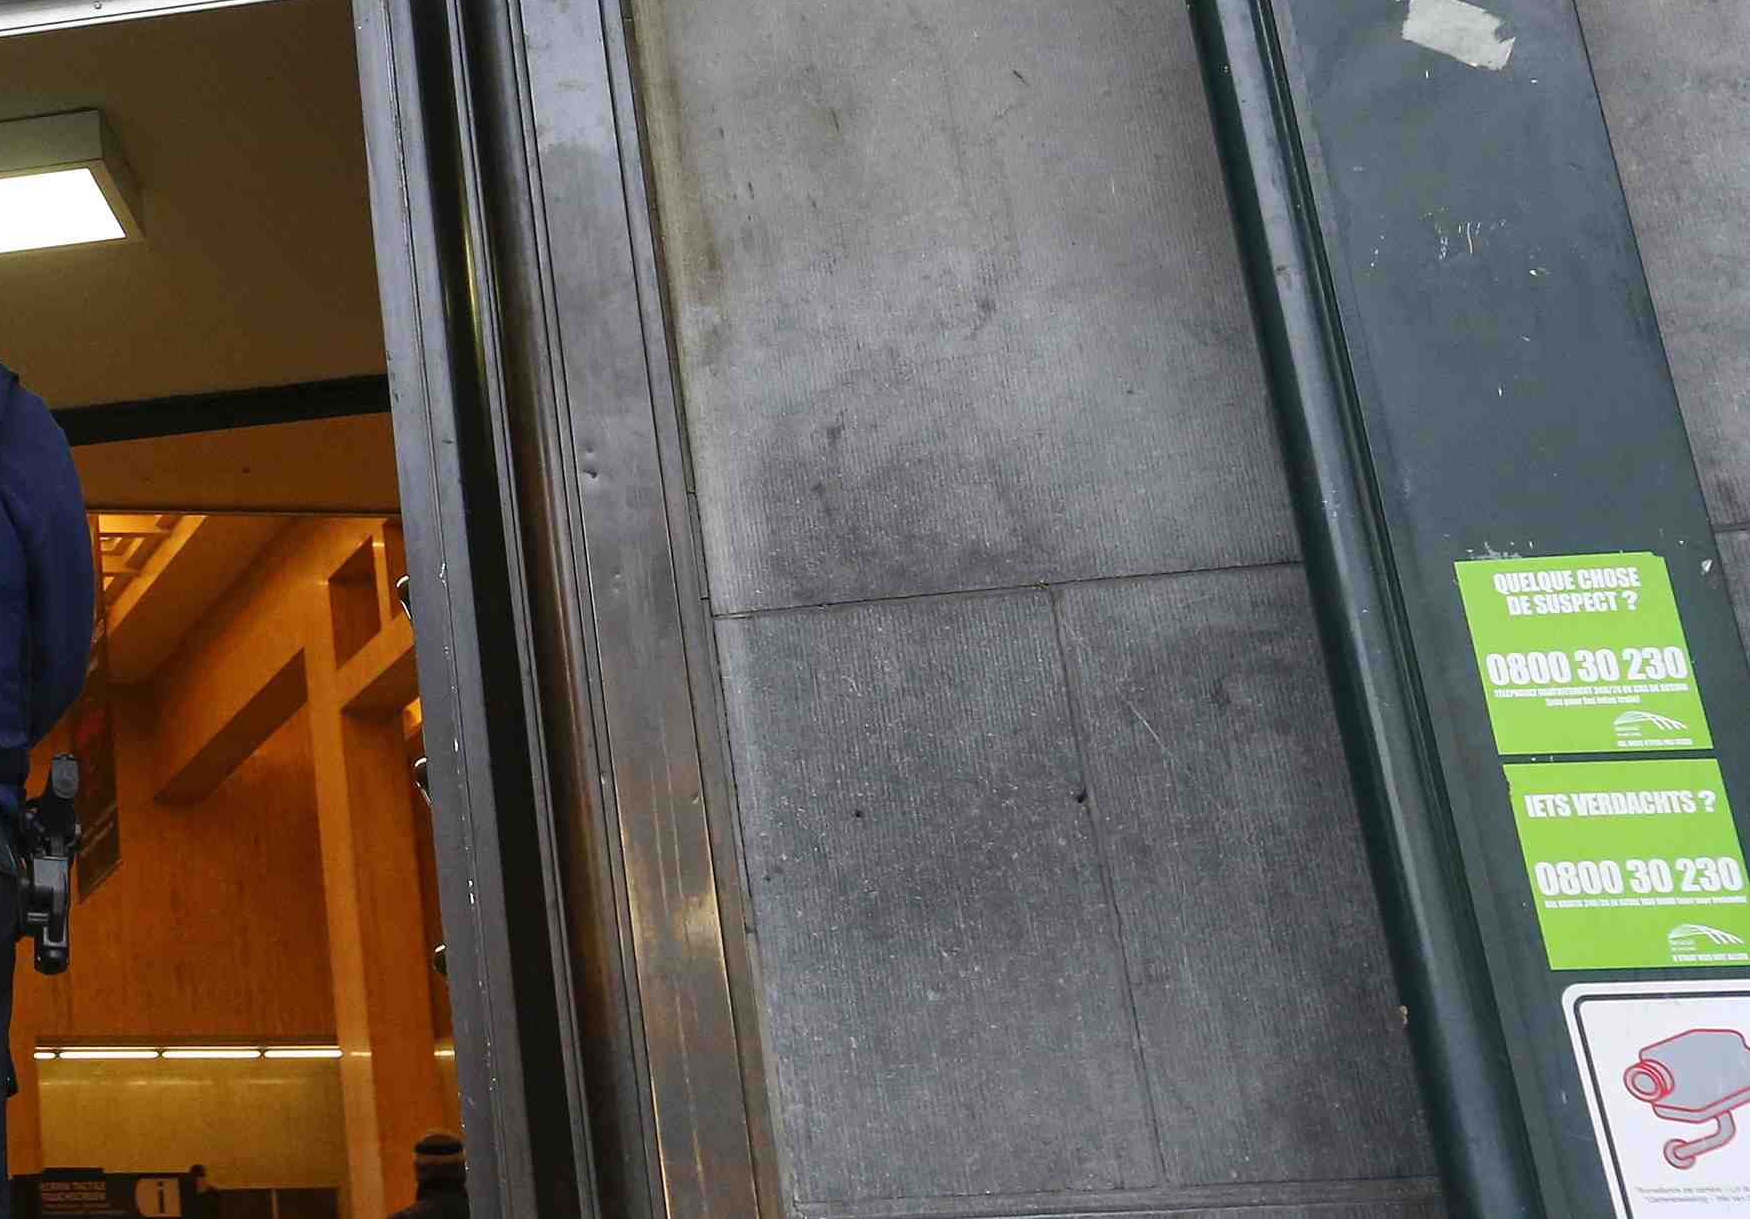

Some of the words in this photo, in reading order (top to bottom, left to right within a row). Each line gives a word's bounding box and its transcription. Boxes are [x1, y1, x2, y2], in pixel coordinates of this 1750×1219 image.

[1493, 570, 1575, 594] QUELQUE
[1577, 567, 1641, 590] CHOSE
[1506, 594, 1533, 616] DE
[1535, 591, 1617, 615] SUSPECT
[1486, 651, 1572, 686] 0800
[1573, 648, 1621, 682] 30
[1622, 646, 1689, 681] 230
[1523, 793, 1571, 818] IETS
[1570, 790, 1697, 817] VERDACHTS
[1534, 860, 1624, 896] 0800
[1625, 858, 1674, 893] 30
[1674, 856, 1744, 892] 230
